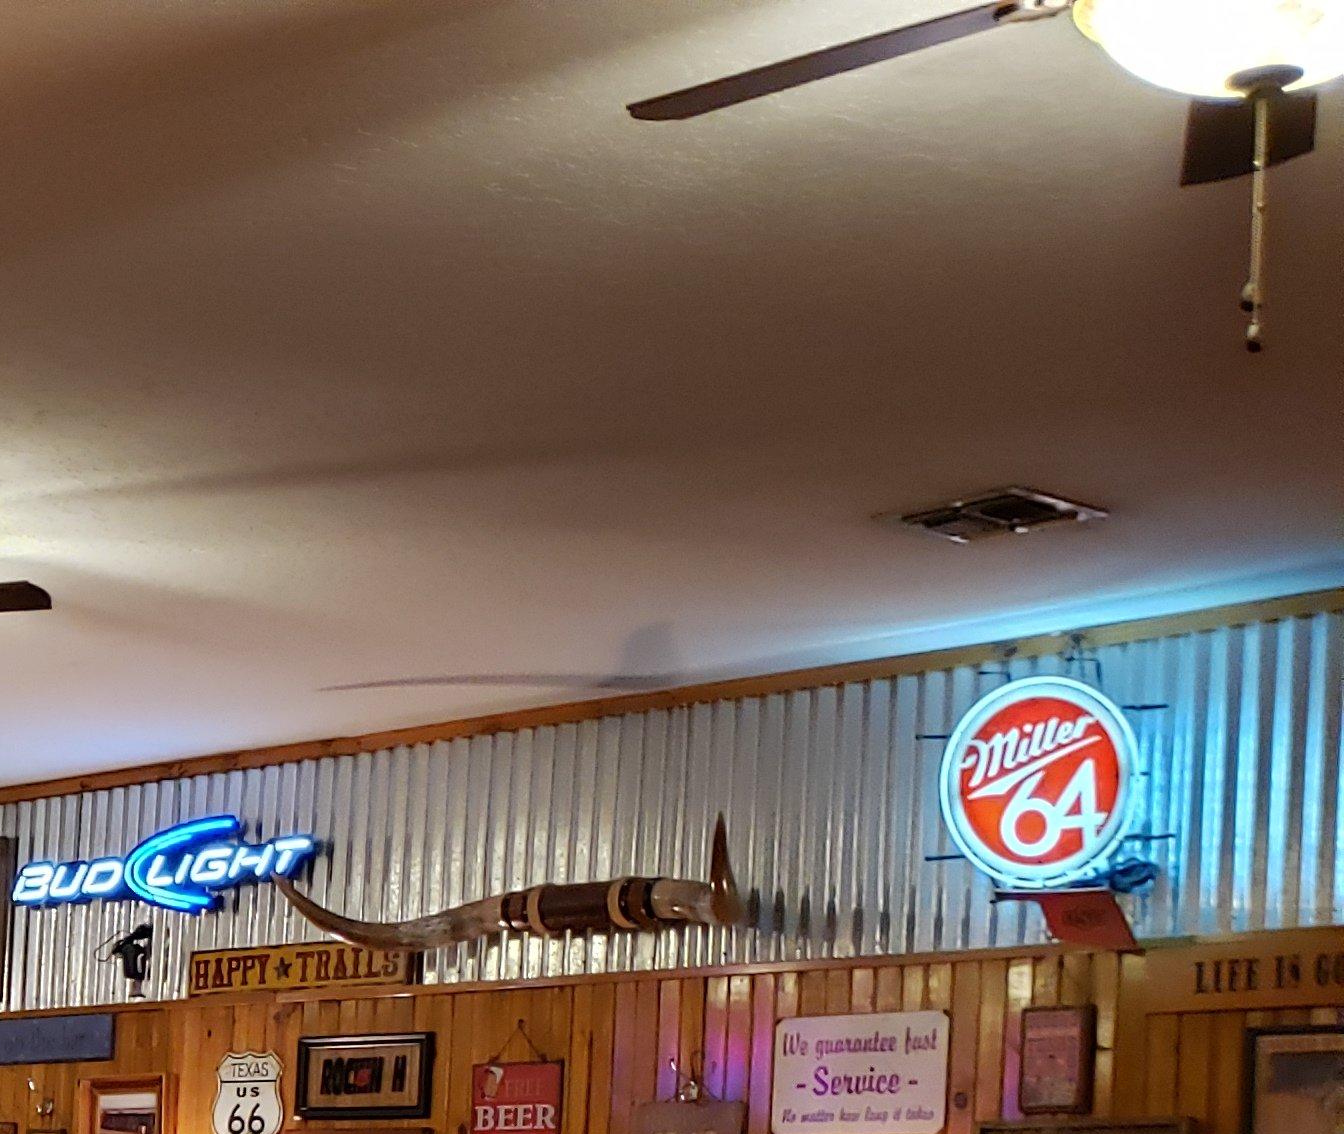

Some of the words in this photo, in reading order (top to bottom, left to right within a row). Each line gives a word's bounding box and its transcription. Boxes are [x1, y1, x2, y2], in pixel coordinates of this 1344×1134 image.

[959, 714, 1099, 788] Miller
[1000, 757, 1109, 858] 64
[11, 859, 124, 903] BUD
[145, 837, 311, 887] LIGHT
[194, 953, 271, 991] HAPPY
[295, 946, 400, 983] TRAILS
[1194, 958, 1259, 994] LIFE
[782, 1032, 809, 1057] We
[815, 1030, 897, 1060] guarantee
[905, 1026, 937, 1055] fast
[231, 1061, 269, 1078] TEXAS
[812, 1065, 900, 1096] Service
[236, 1086, 261, 1098] US
[473, 1103, 556, 1132] BEER
